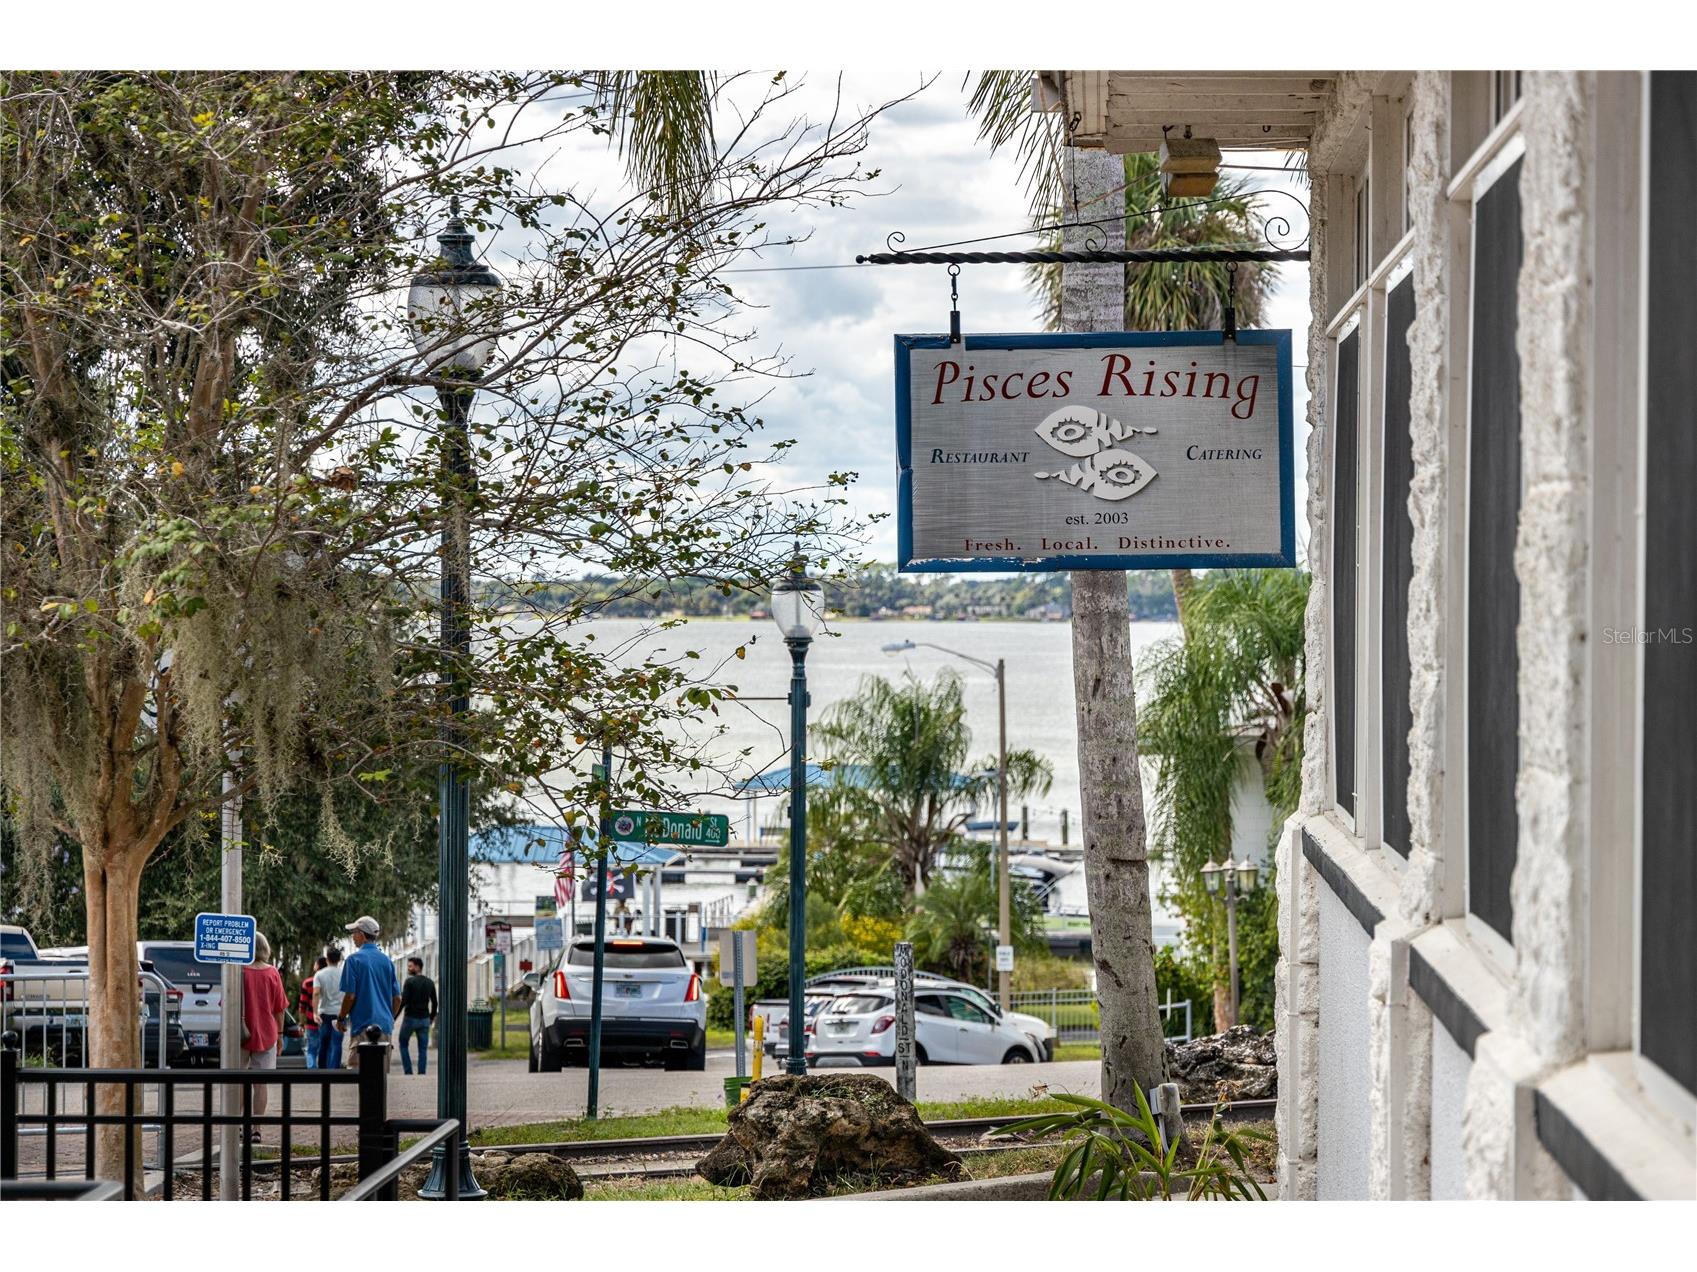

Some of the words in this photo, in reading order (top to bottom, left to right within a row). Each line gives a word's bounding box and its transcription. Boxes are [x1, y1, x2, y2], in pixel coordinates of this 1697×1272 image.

[931, 360, 1073, 405] Pisces
[1097, 353, 1260, 420] Rising
[930, 448, 1031, 464] RESTAURANT
[1186, 444, 1263, 461] CATERING
[1065, 514, 1089, 525] est.
[1094, 512, 1129, 525] 2003
[964, 538, 1021, 551] Fresh.
[1041, 536, 1098, 550] Local.
[1118, 535, 1231, 549] Distinctive.
[636, 816, 642, 827] N
[644, 817, 703, 840] Donald
[710, 816, 718, 828] St
[202, 919, 223, 927] REPORT
[224, 920, 249, 928] PROBLEM
[215, 928, 246, 936] EMERGENCY
[898, 1042, 911, 1054] ST
